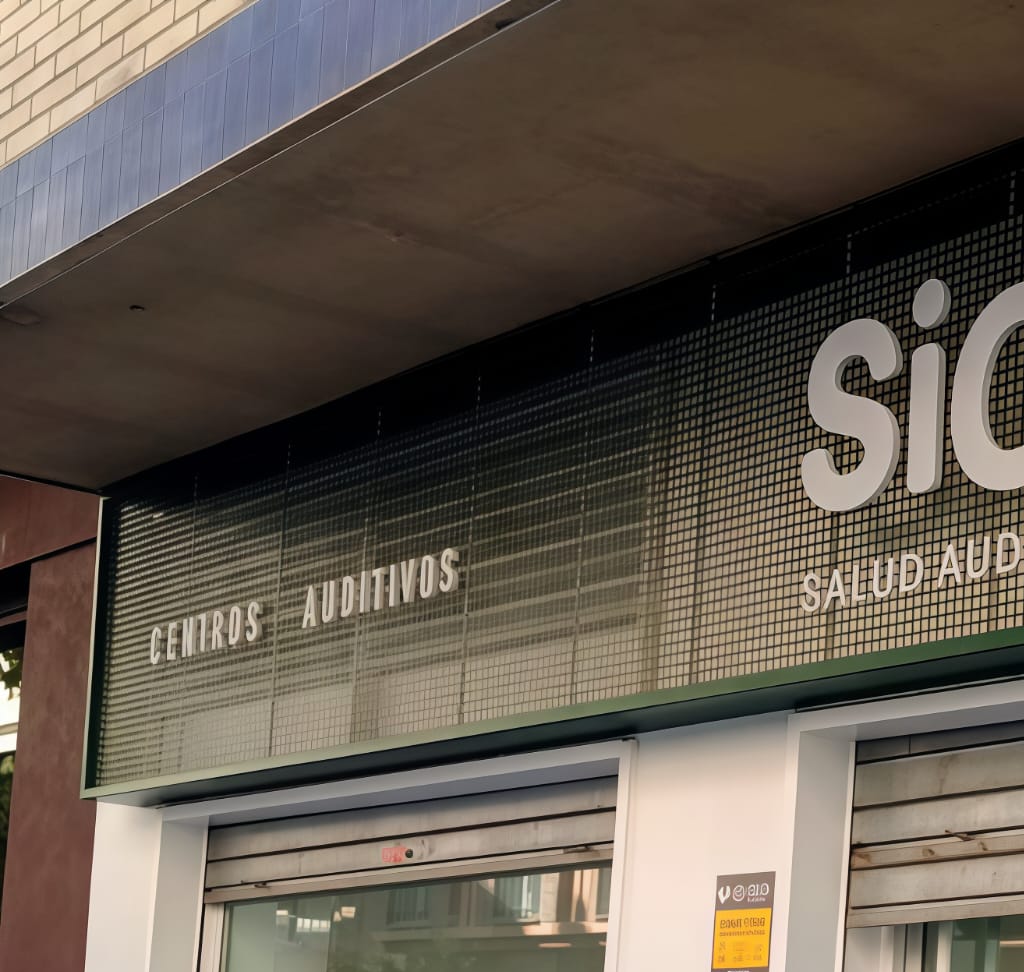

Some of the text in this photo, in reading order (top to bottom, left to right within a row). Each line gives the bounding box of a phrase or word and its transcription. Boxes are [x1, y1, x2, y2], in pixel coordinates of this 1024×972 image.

[150, 548, 459, 664] CENTROS AUDITIVOS
[800, 553, 925, 613] SALUD
